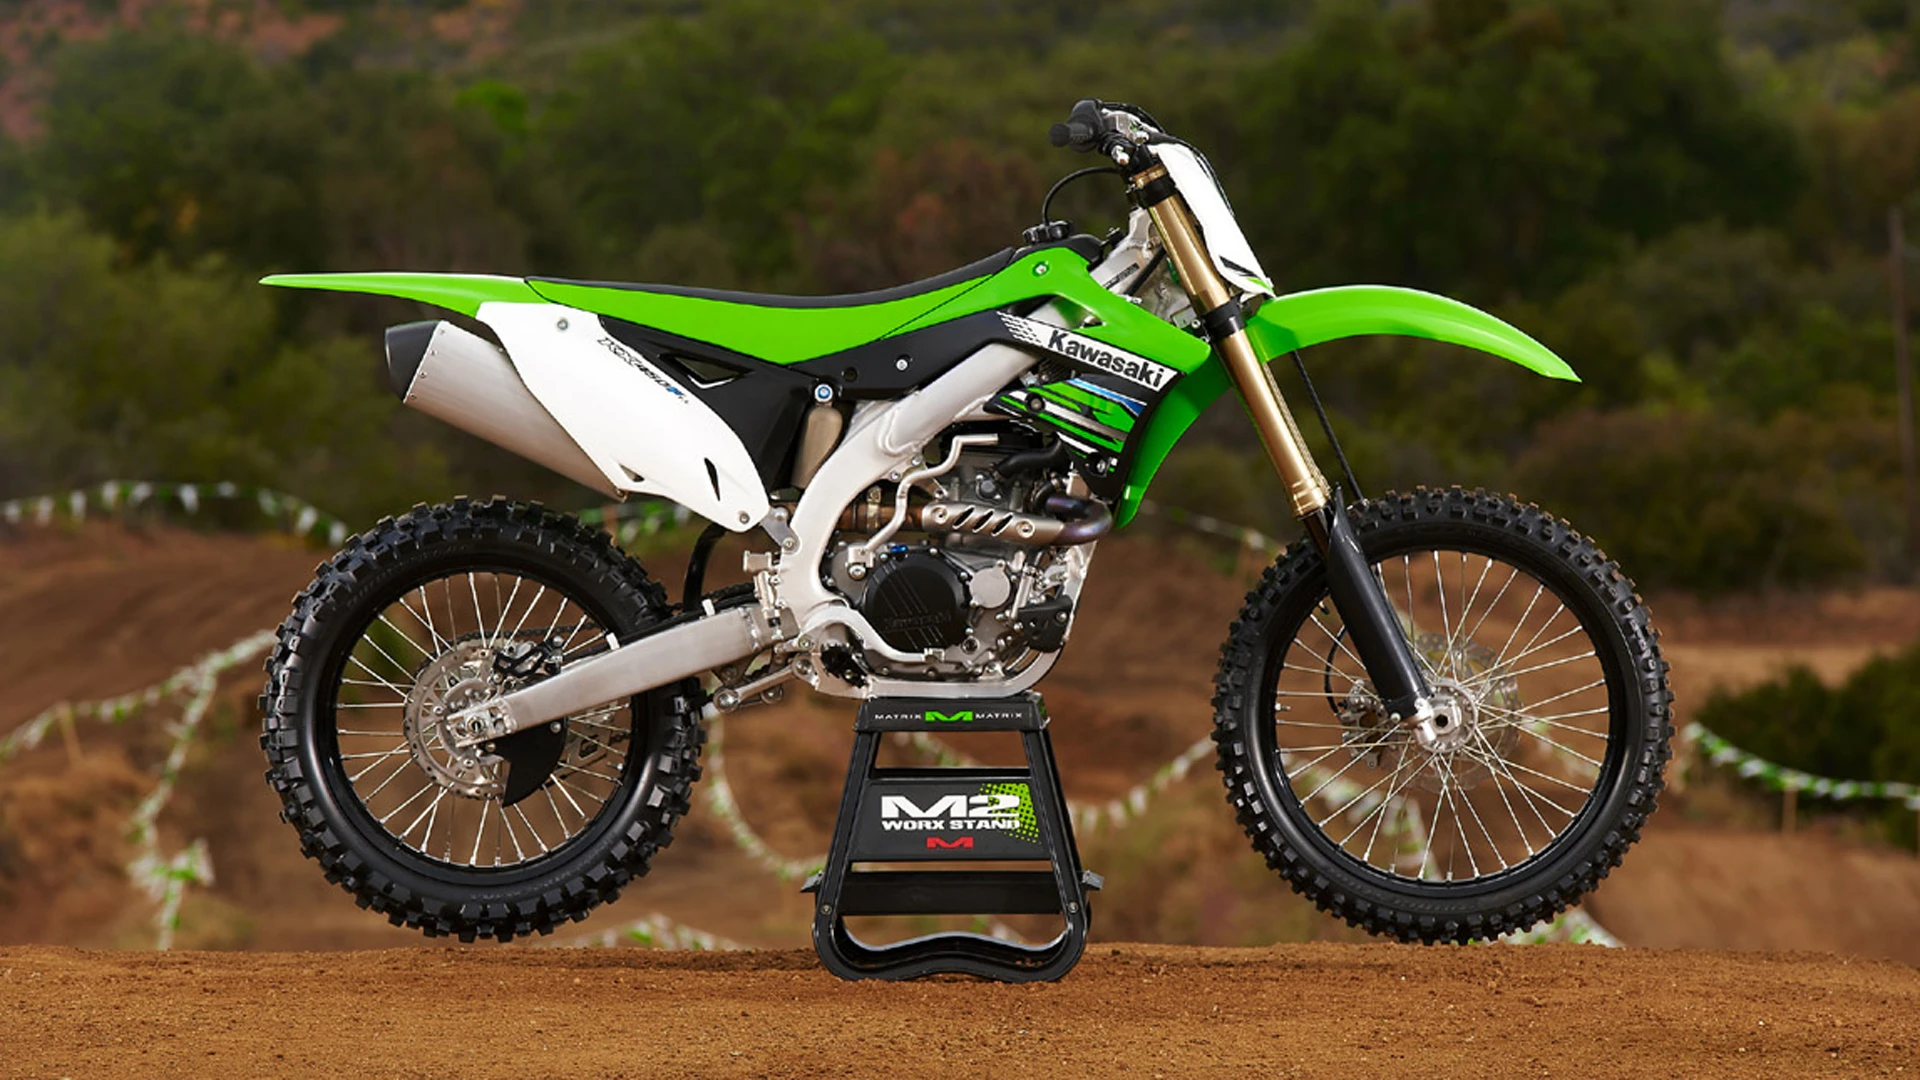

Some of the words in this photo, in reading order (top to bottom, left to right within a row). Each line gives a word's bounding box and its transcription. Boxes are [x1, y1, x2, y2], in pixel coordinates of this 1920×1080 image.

[1048, 330, 1164, 386] Kawasaki
[881, 795, 1020, 818] M2
[882, 820, 944, 830] WORX
[950, 819, 1021, 830] STAND
